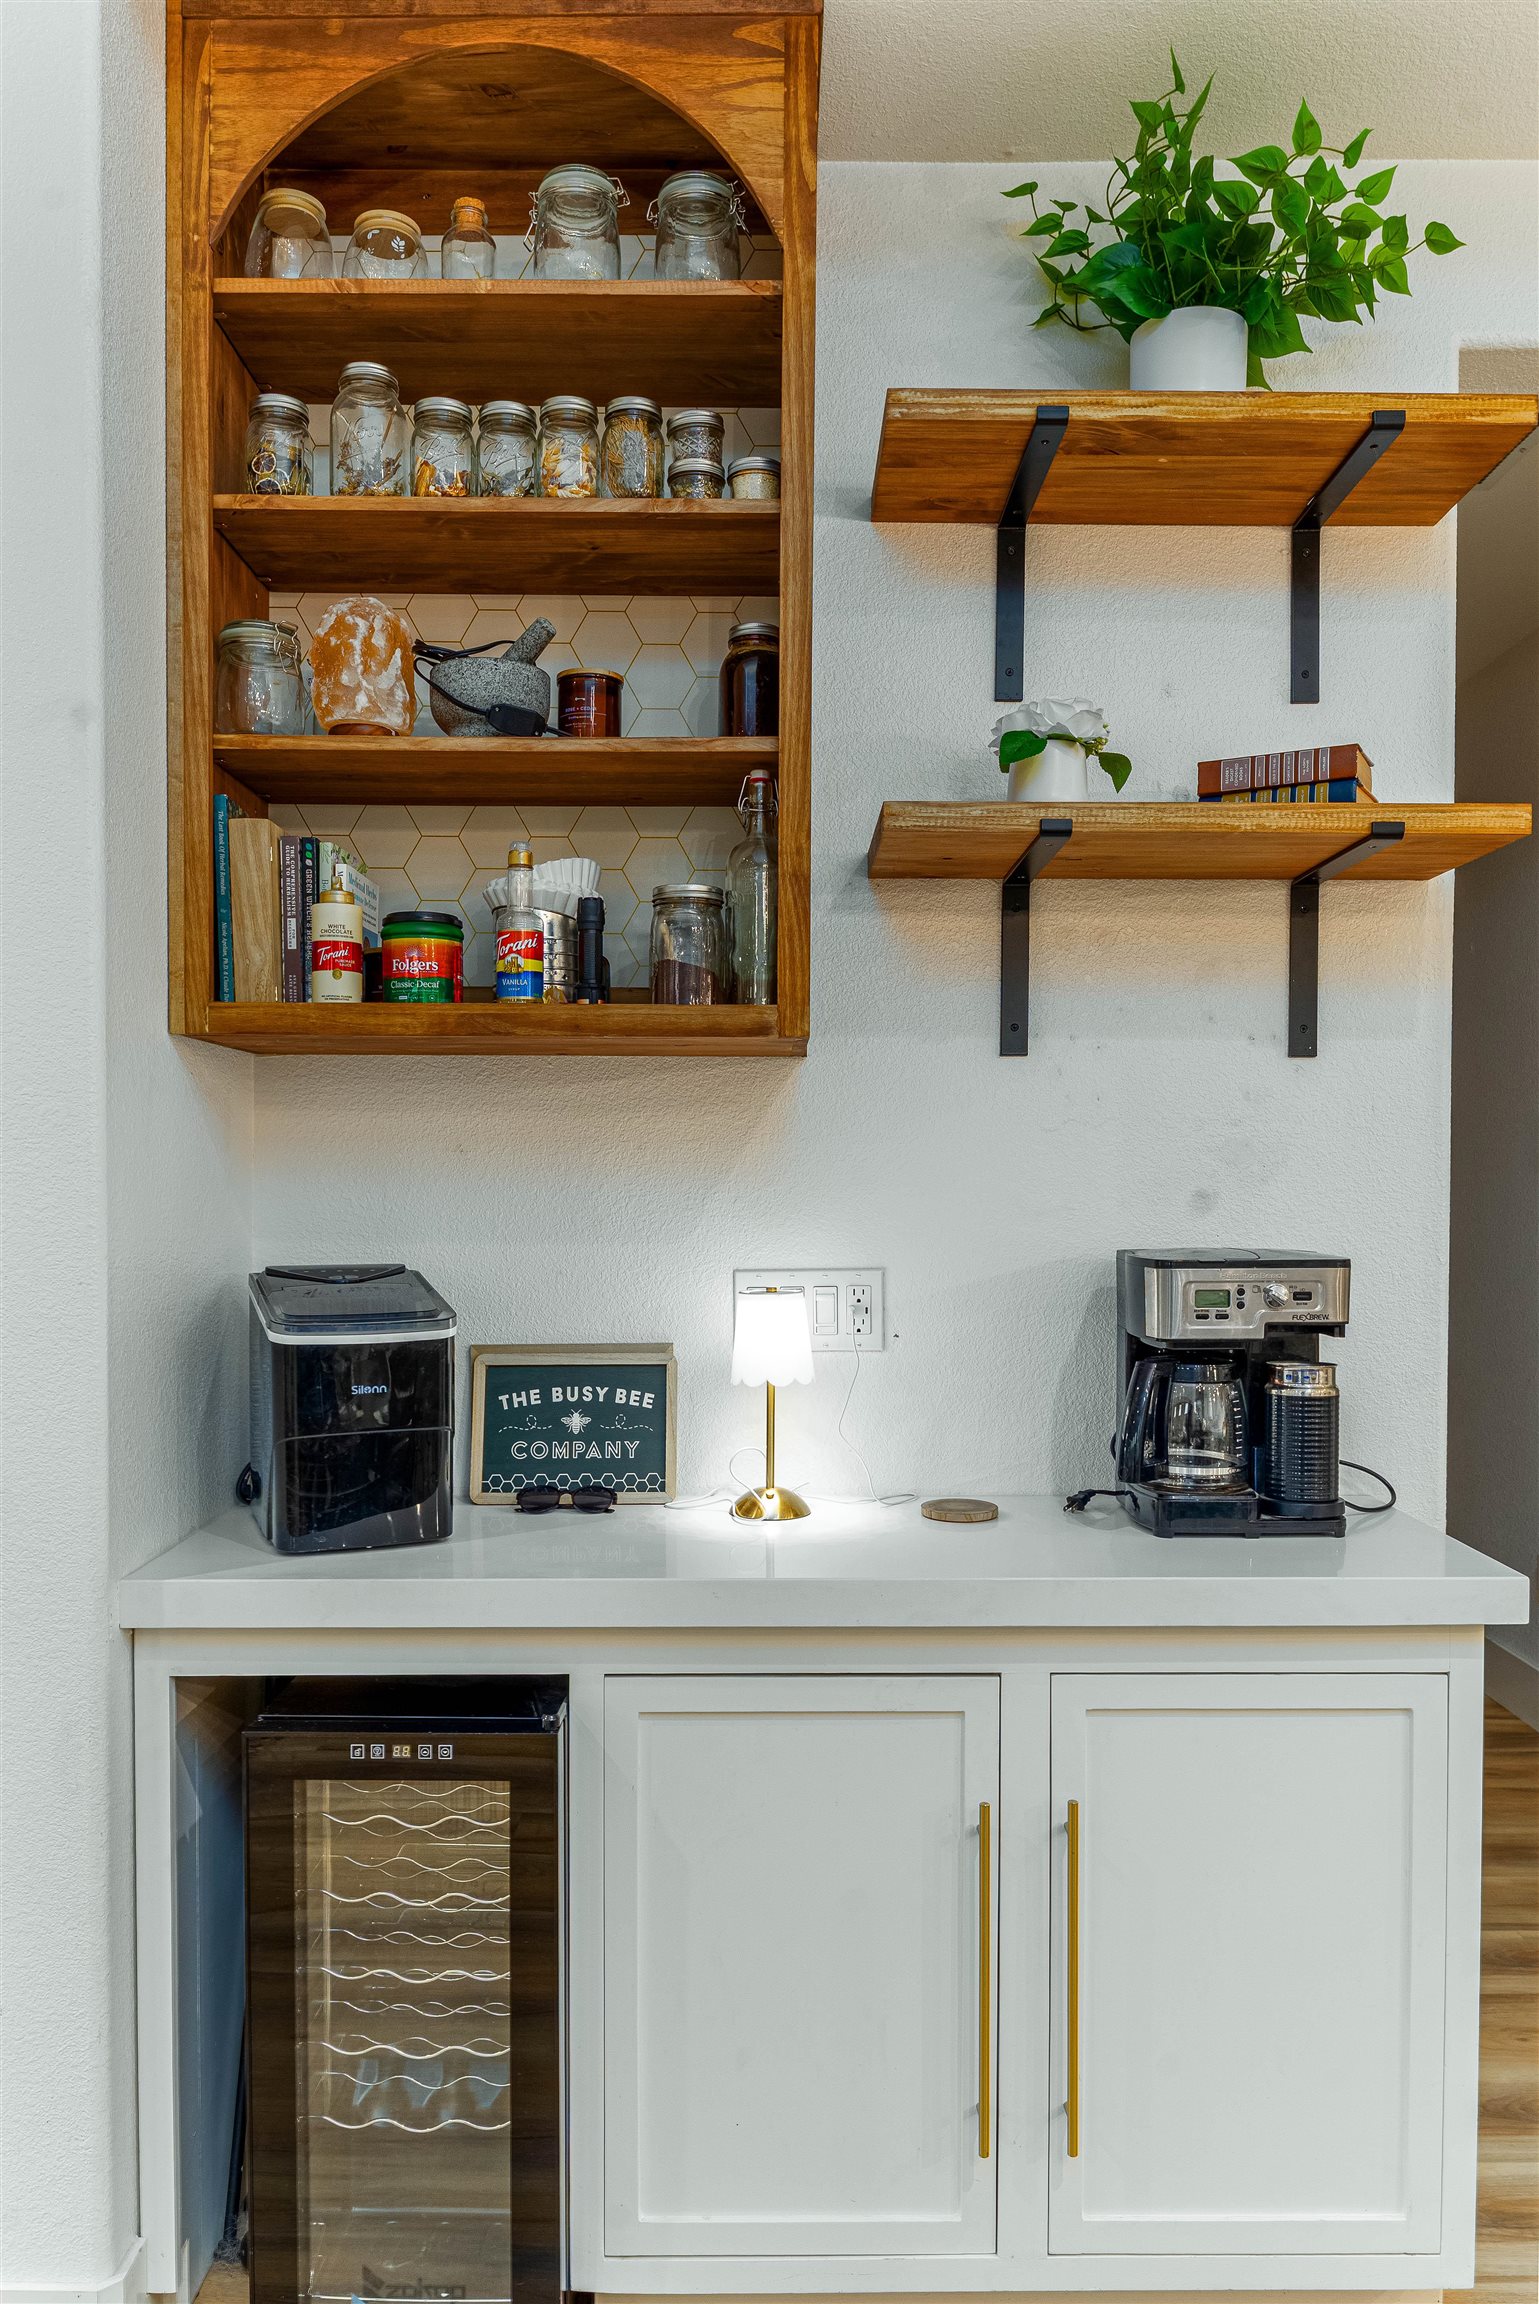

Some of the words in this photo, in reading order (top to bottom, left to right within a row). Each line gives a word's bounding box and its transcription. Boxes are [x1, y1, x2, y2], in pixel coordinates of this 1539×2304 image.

[286, 867, 291, 876] TO
[305, 868, 313, 894] GREEN
[317, 945, 350, 966] Torani
[496, 933, 538, 963] Torani
[392, 959, 439, 974] Folgers
[390, 980, 415, 989] Classic
[416, 980, 440, 989] Decaf
[502, 978, 529, 986] VANILLA
[351, 1385, 387, 1395] Silonn
[498, 1389, 542, 1410] THE
[551, 1385, 609, 1403] BUSY
[615, 1388, 655, 1409] BEE
[511, 1441, 641, 1460] COMPANY
